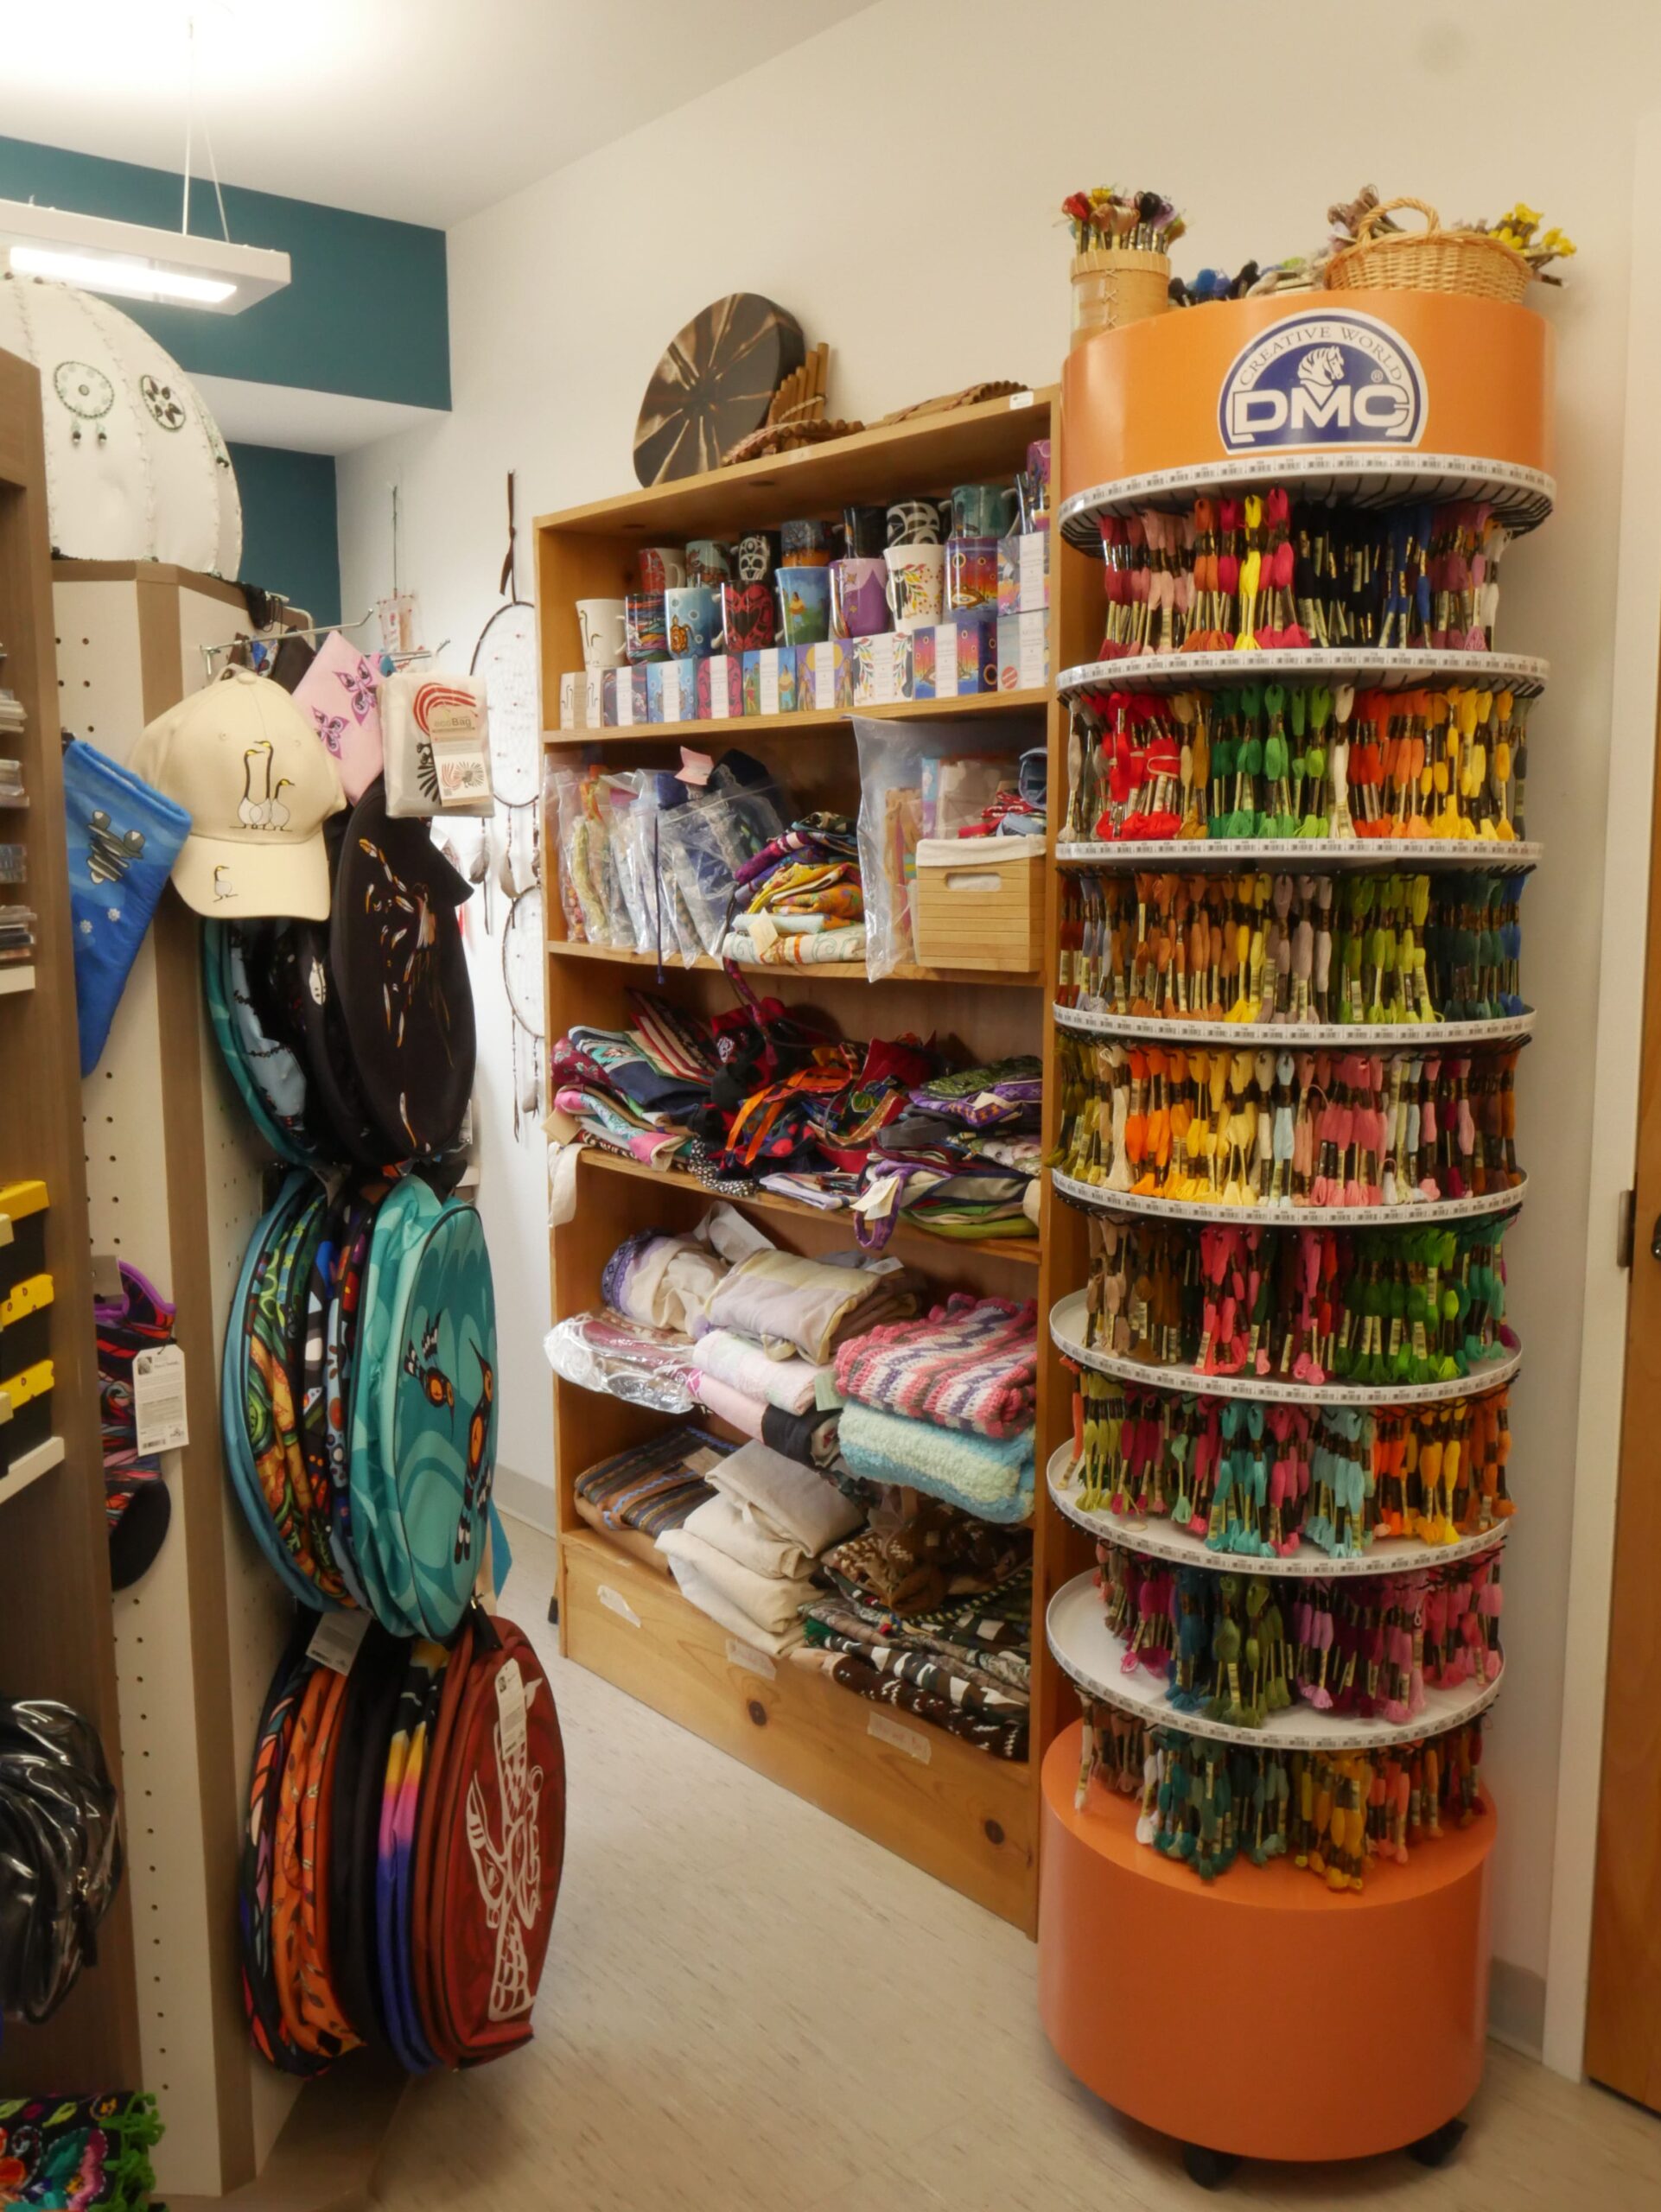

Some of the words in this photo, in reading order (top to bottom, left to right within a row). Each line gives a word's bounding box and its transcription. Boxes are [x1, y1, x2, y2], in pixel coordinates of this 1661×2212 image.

[1239, 326, 1332, 385] CREATIVE
[1340, 327, 1403, 382] WORLD
[1232, 384, 1410, 439] DMC
